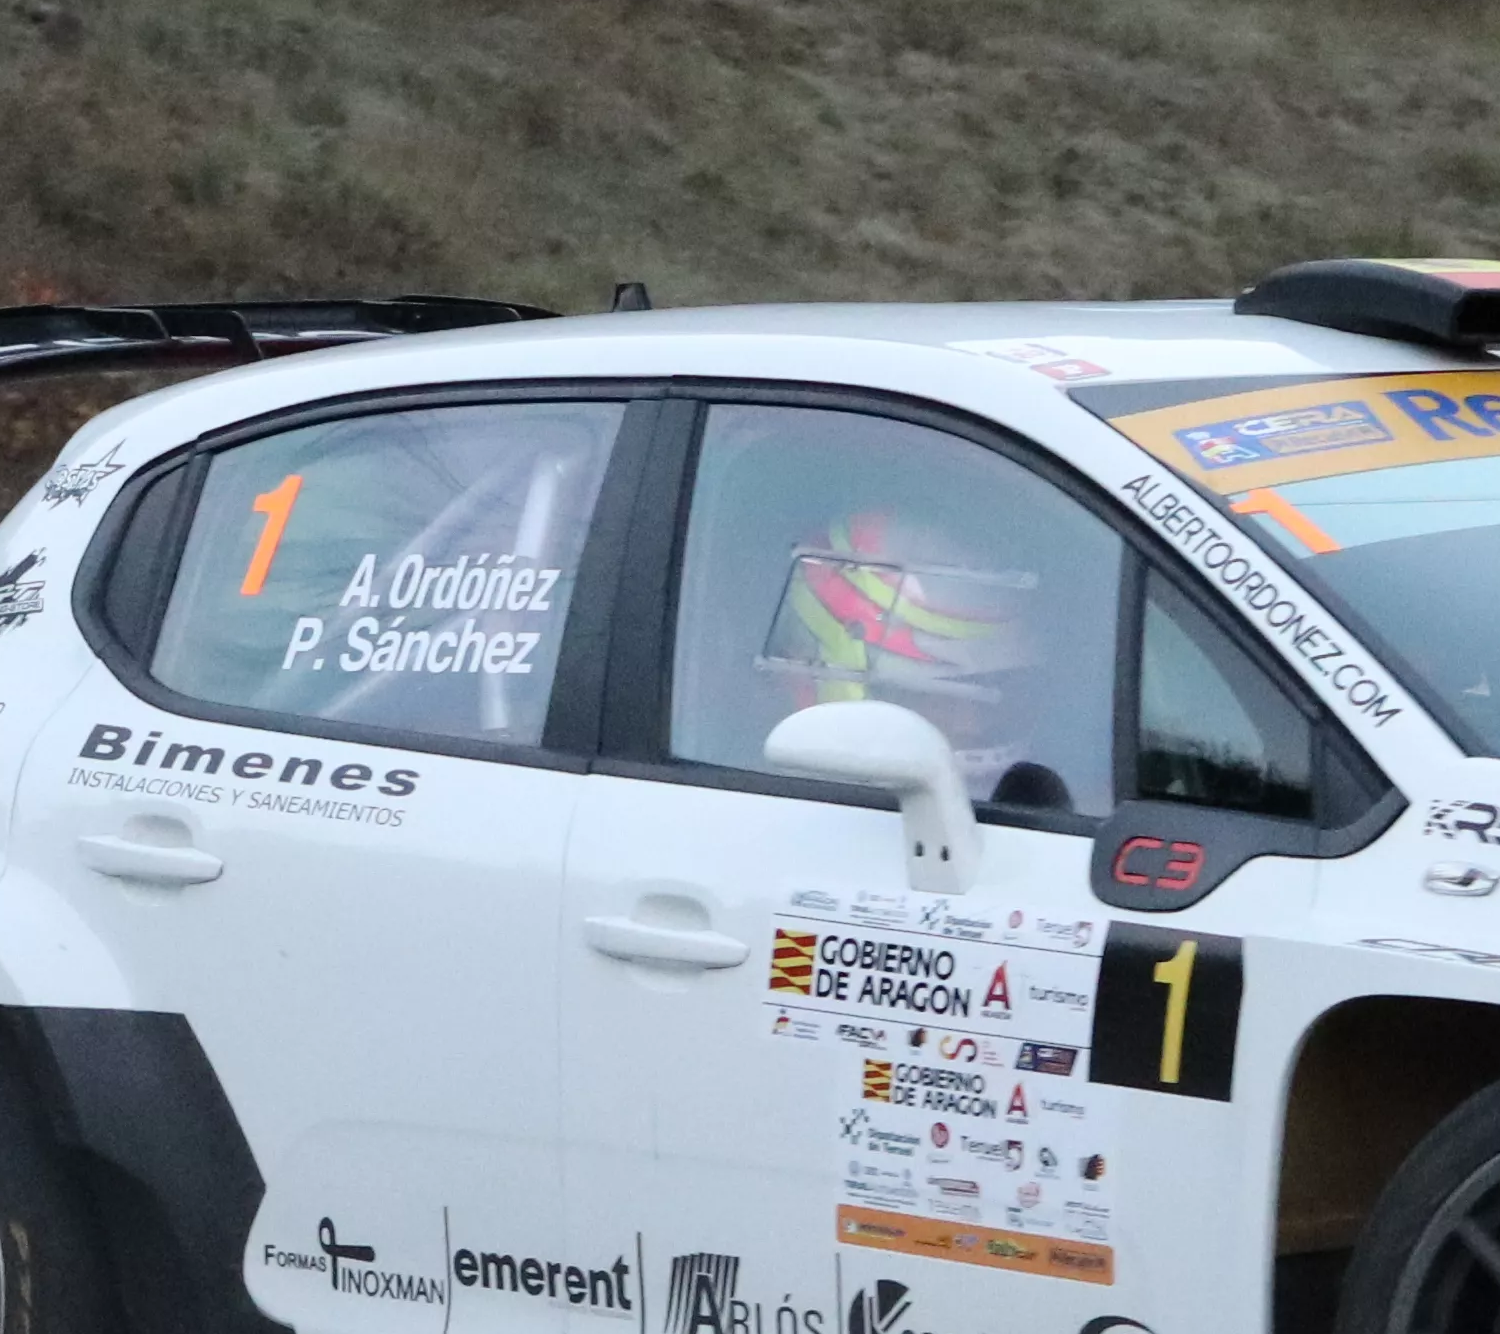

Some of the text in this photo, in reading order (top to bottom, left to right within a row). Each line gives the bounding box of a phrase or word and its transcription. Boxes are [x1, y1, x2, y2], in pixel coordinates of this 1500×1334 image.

[240, 474, 303, 596] 1
[1228, 487, 1342, 555] 1
[340, 552, 562, 611] A. Ordóñez
[1121, 474, 1403, 729] ALBERTOORDONEZ.COM
[282, 615, 542, 674] P. Sánchez
[77, 722, 421, 798] Bimenes
[66, 767, 407, 828] INSTALACIONES Y SANEAMIENTOS
[1112, 835, 1206, 890] C3
[819, 935, 956, 981] GOBIERNO
[816, 968, 973, 1018] DE ARAGON
[1152, 940, 1199, 1085] 1
[892, 1085, 998, 1119] DE ARAGON
[894, 1062, 987, 1095] GOBIERNO
[340, 1267, 446, 1306] INOXMAN
[454, 1247, 632, 1312] emerent
